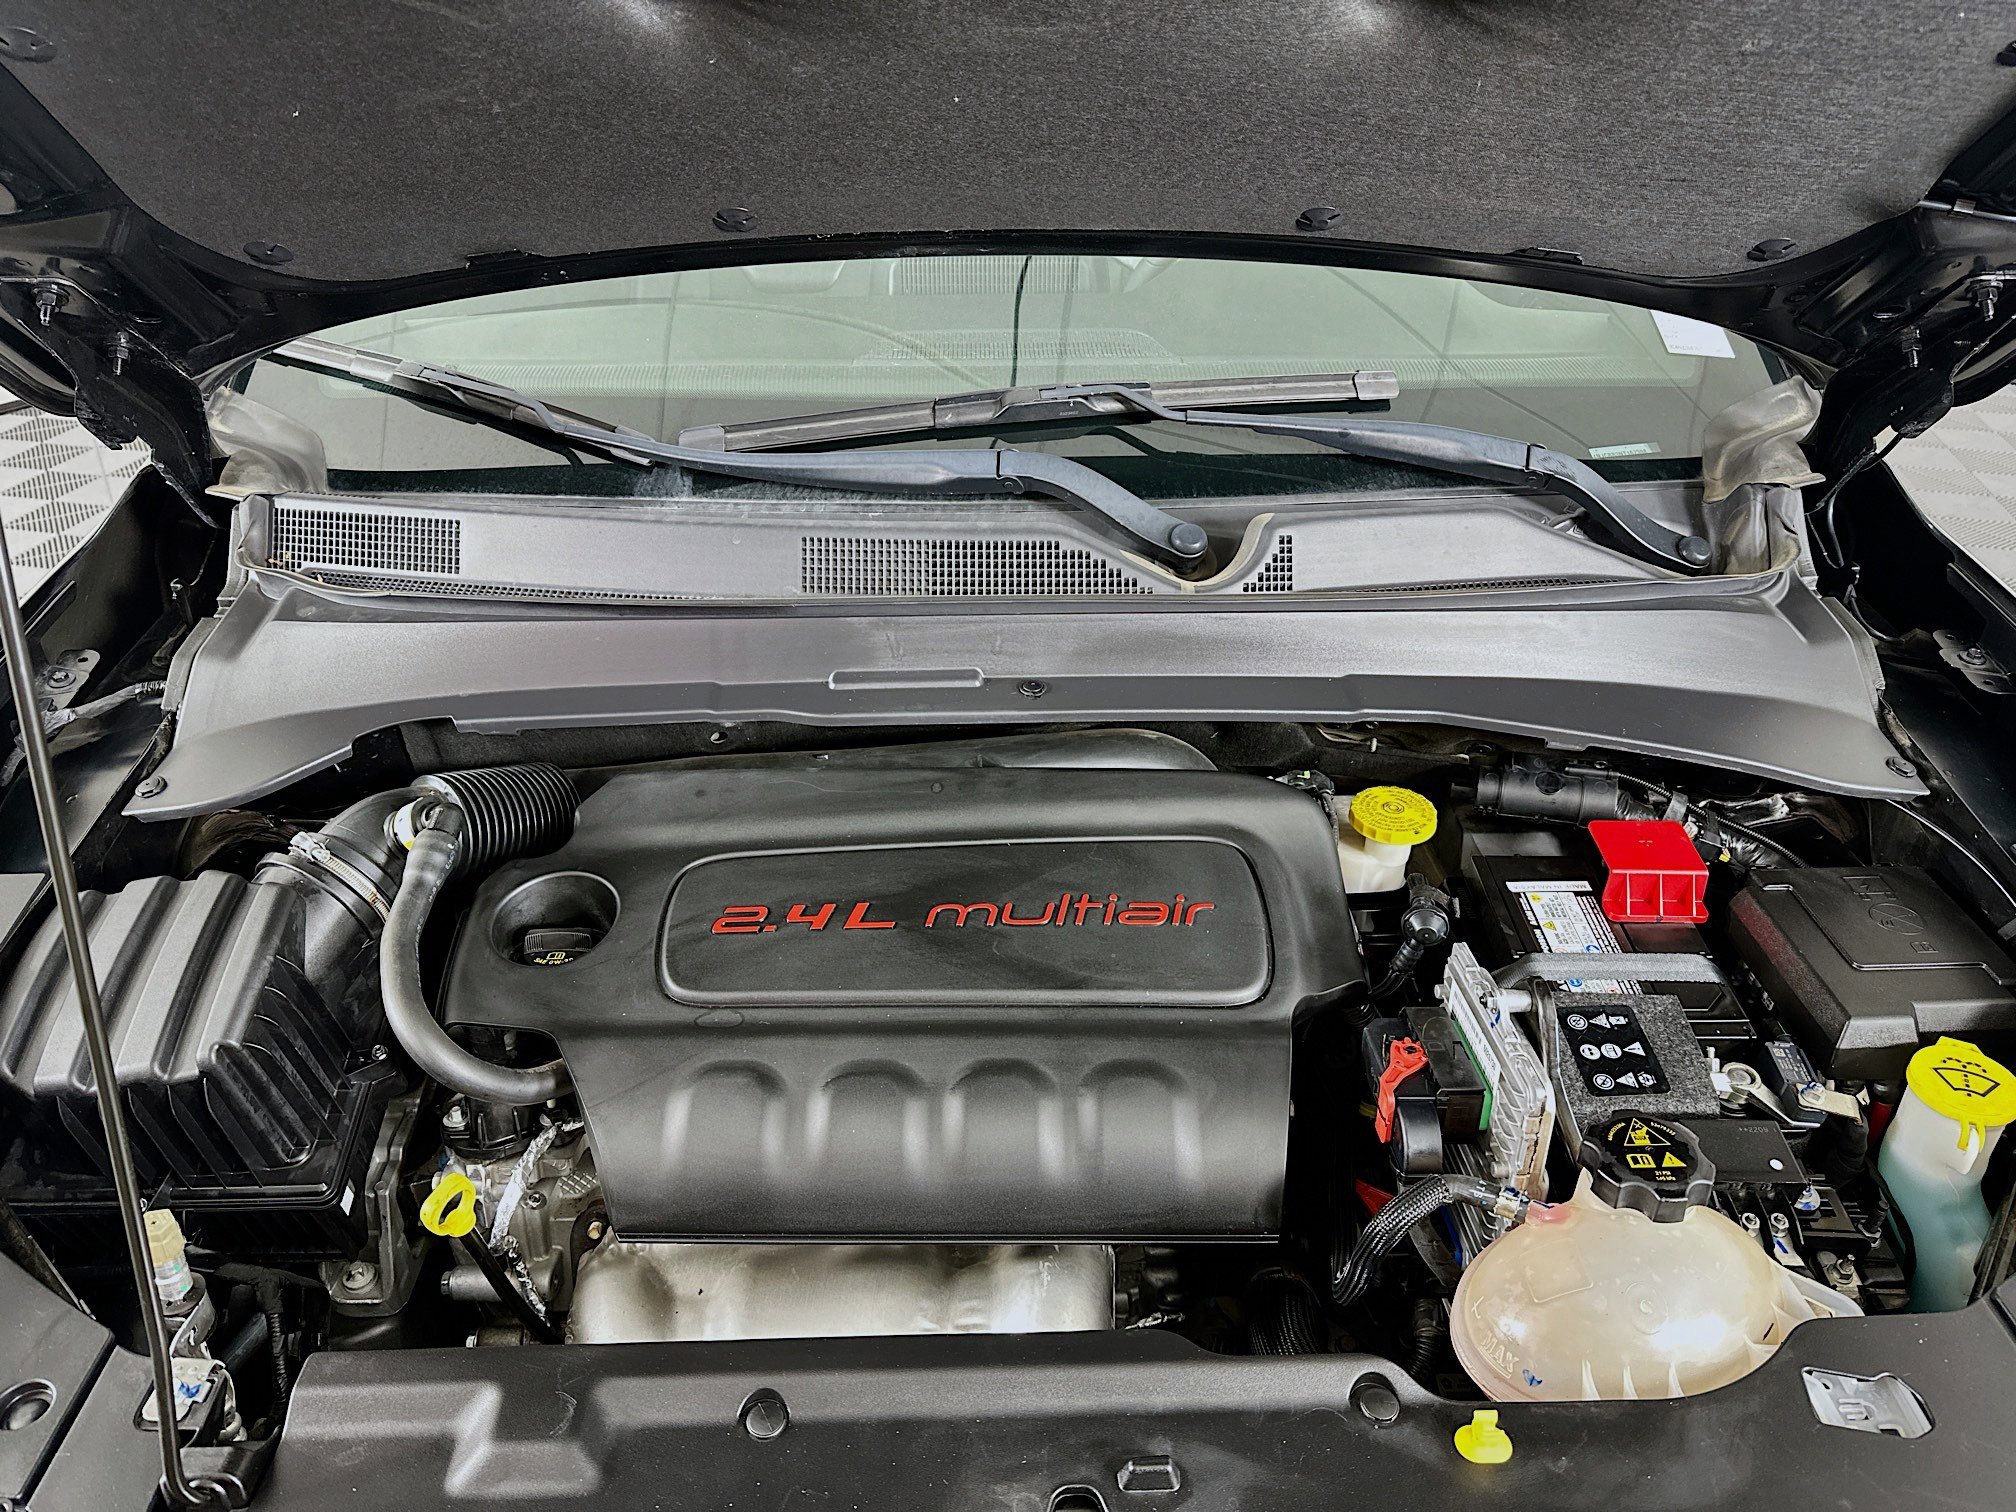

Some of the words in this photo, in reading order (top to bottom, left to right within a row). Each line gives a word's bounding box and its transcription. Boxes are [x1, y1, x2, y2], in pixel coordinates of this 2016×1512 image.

[925, 893, 1215, 927] multiair
[534, 957, 548, 965] SAE
[1480, 1330, 1520, 1373] MAX
